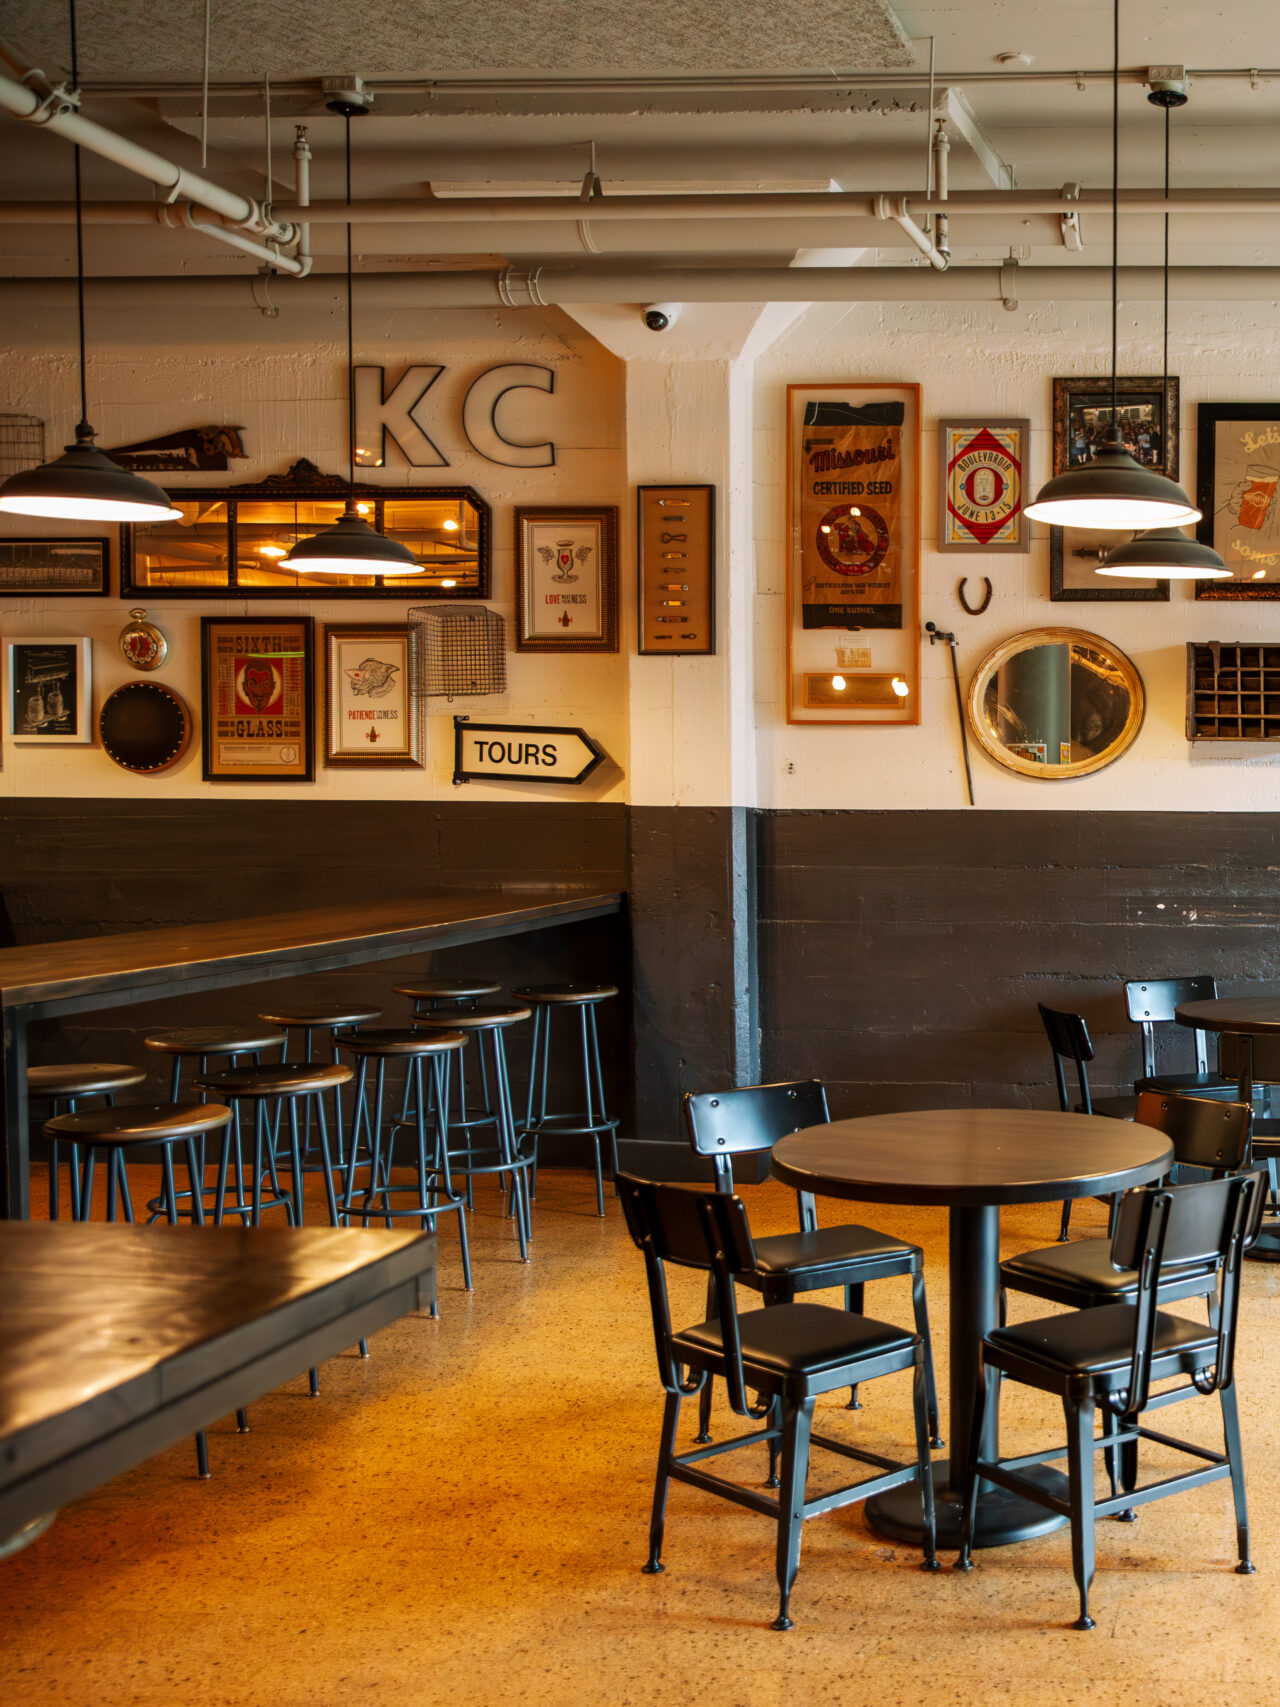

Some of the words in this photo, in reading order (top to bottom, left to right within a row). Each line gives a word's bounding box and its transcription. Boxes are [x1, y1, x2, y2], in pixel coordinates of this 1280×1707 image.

[354, 363, 555, 468] KC
[809, 438, 895, 473] Missouri
[957, 451, 1013, 473] BOULEVARDIA
[813, 481, 864, 496] CERTIFIED
[866, 481, 893, 496] SEED
[957, 503, 981, 522] JUNE
[984, 501, 1012, 523] 13-15
[1231, 539, 1279, 566] some
[545, 594, 561, 605] LOVE
[828, 606, 845, 614] ONE
[235, 635, 282, 653] SIXTH
[348, 710, 376, 720] PATIENCE
[236, 720, 283, 737] GLASS
[474, 740, 557, 766] TOURS
